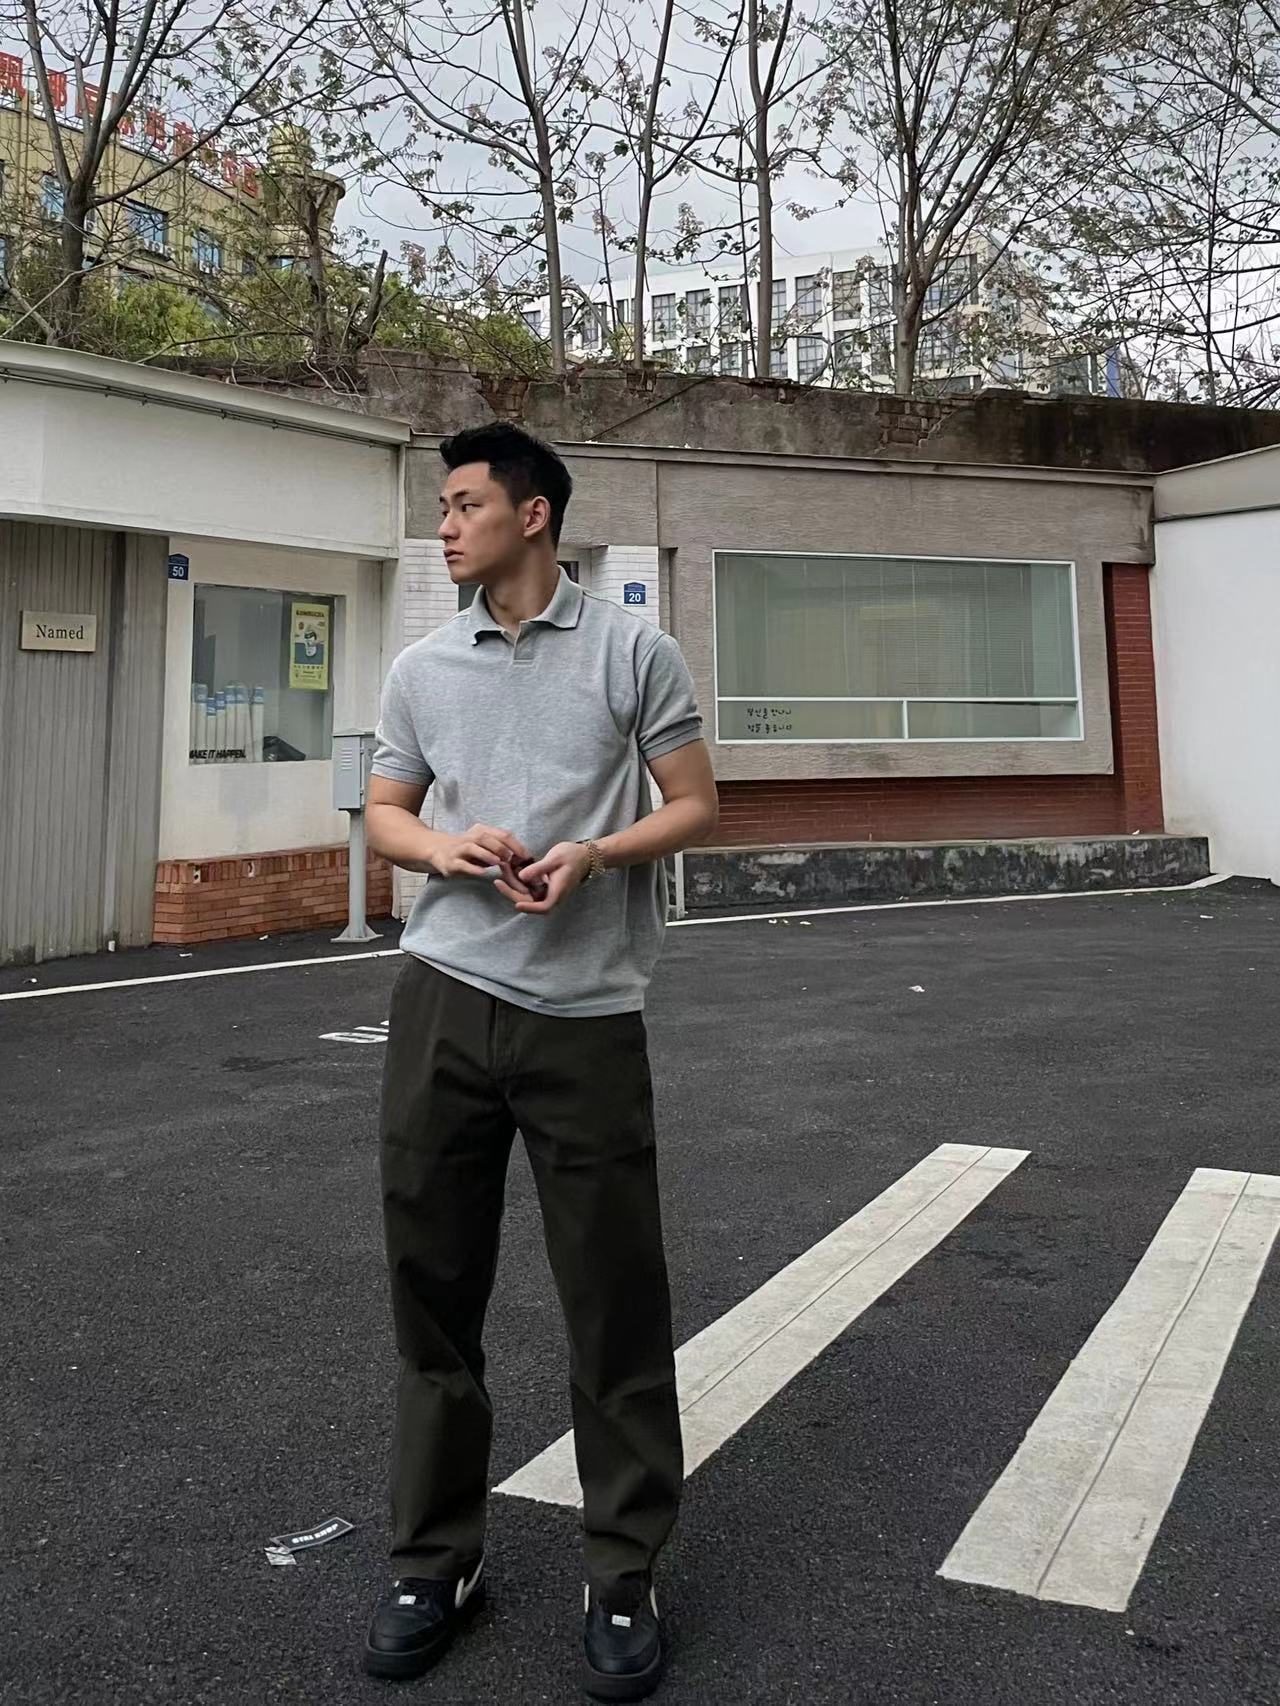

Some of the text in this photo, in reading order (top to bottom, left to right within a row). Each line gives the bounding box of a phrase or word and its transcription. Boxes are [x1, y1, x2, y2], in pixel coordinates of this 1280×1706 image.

[172, 566, 184, 577] 50
[628, 592, 641, 602] 20
[36, 624, 84, 640] Named
[208, 749, 216, 759] IT
